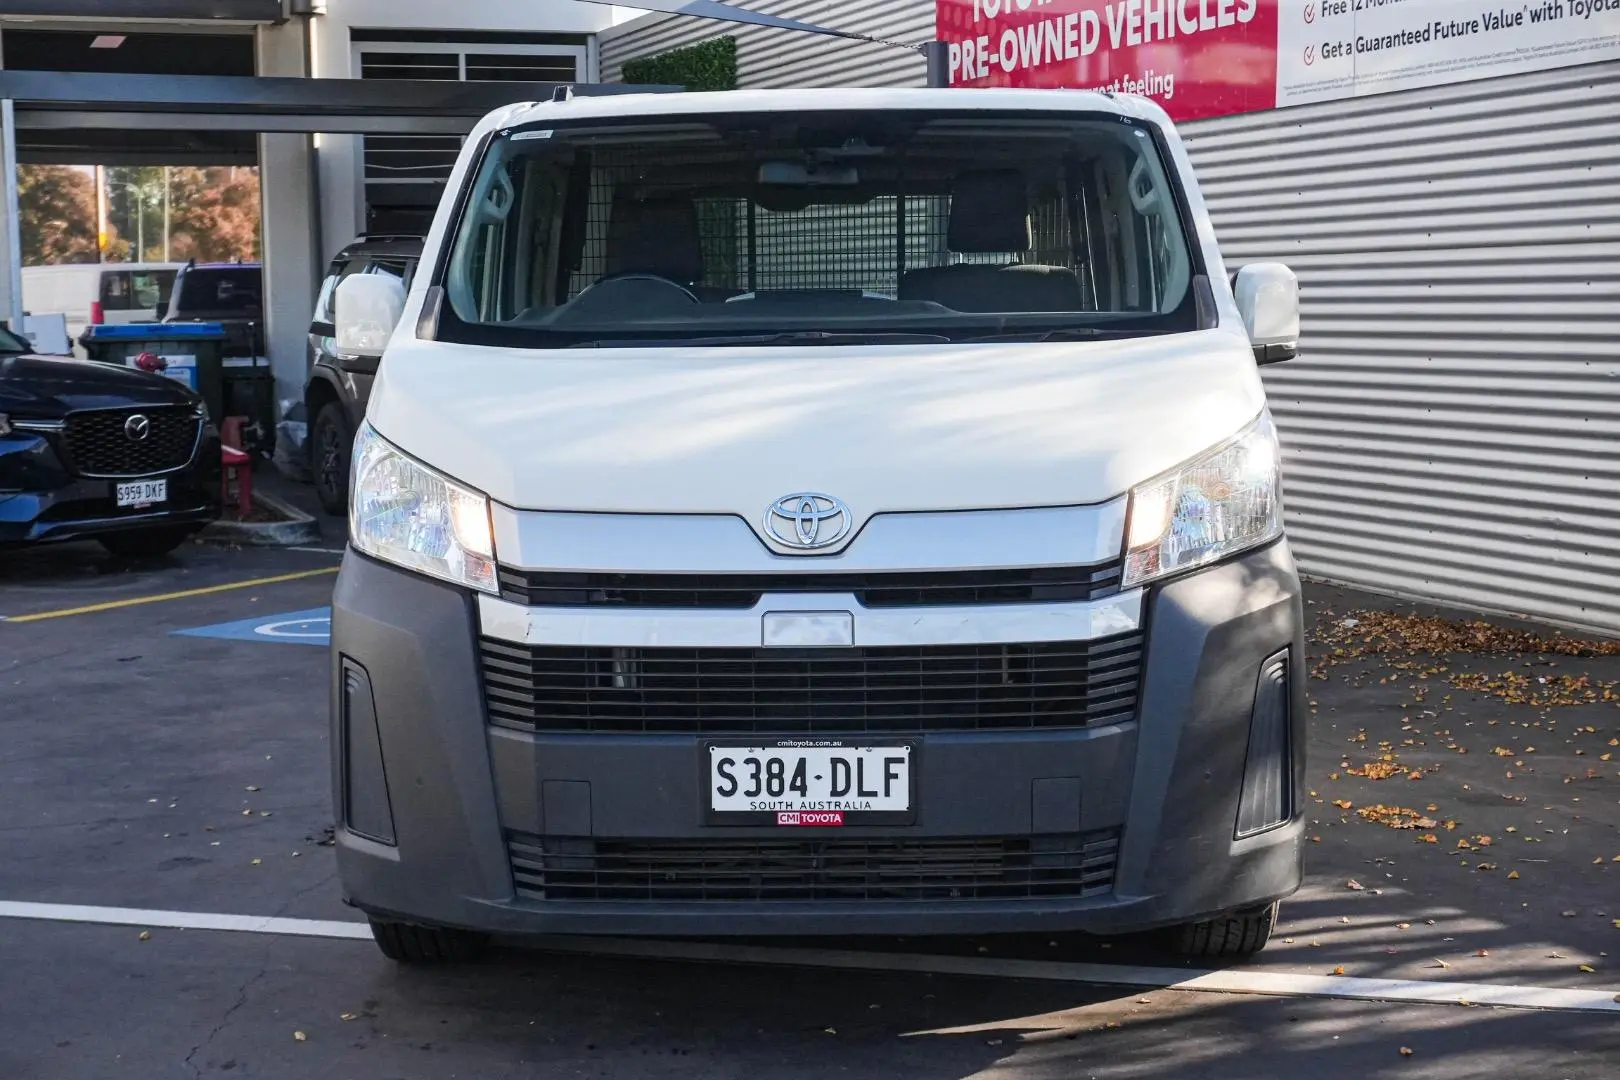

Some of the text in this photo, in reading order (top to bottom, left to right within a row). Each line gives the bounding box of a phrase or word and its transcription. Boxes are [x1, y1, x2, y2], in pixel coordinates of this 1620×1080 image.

[1322, 0, 1347, 17] Free
[1321, 41, 1346, 59] Get
[1346, 43, 1352, 55] a
[1355, 22, 1431, 53] Guaranteed
[1434, 19, 1479, 40] Future
[1530, 2, 1563, 23] with
[949, 9, 1100, 84] PRE-OWNED
[1122, 69, 1174, 99] feeling
[750, 801, 872, 810] SOUTH AUSTRALIA
[780, 814, 841, 823] CMI TOYOTA
